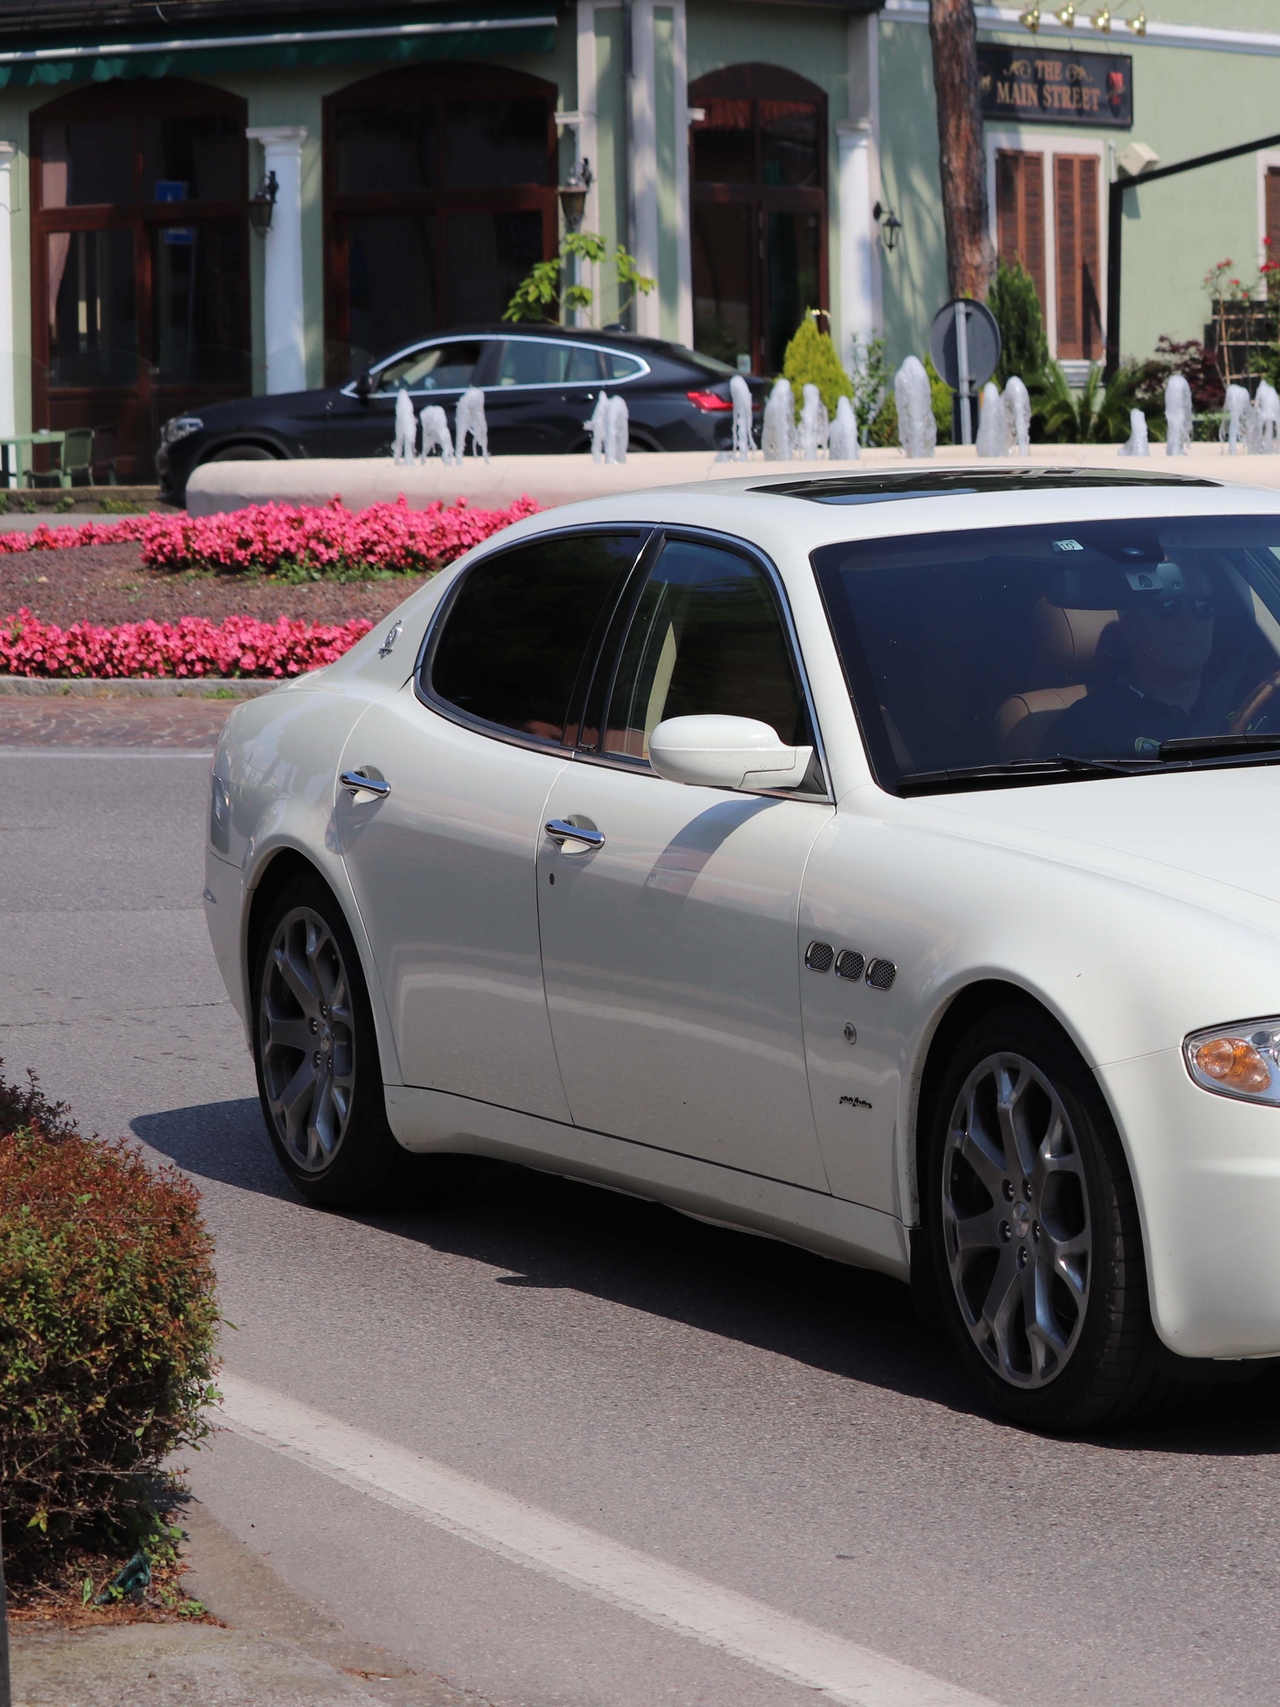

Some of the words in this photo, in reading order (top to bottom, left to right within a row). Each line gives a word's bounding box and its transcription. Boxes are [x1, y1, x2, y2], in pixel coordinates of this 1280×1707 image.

[1035, 60, 1063, 81] THE
[996, 81, 1038, 107] MAIN
[1043, 85, 1101, 111] STREET
